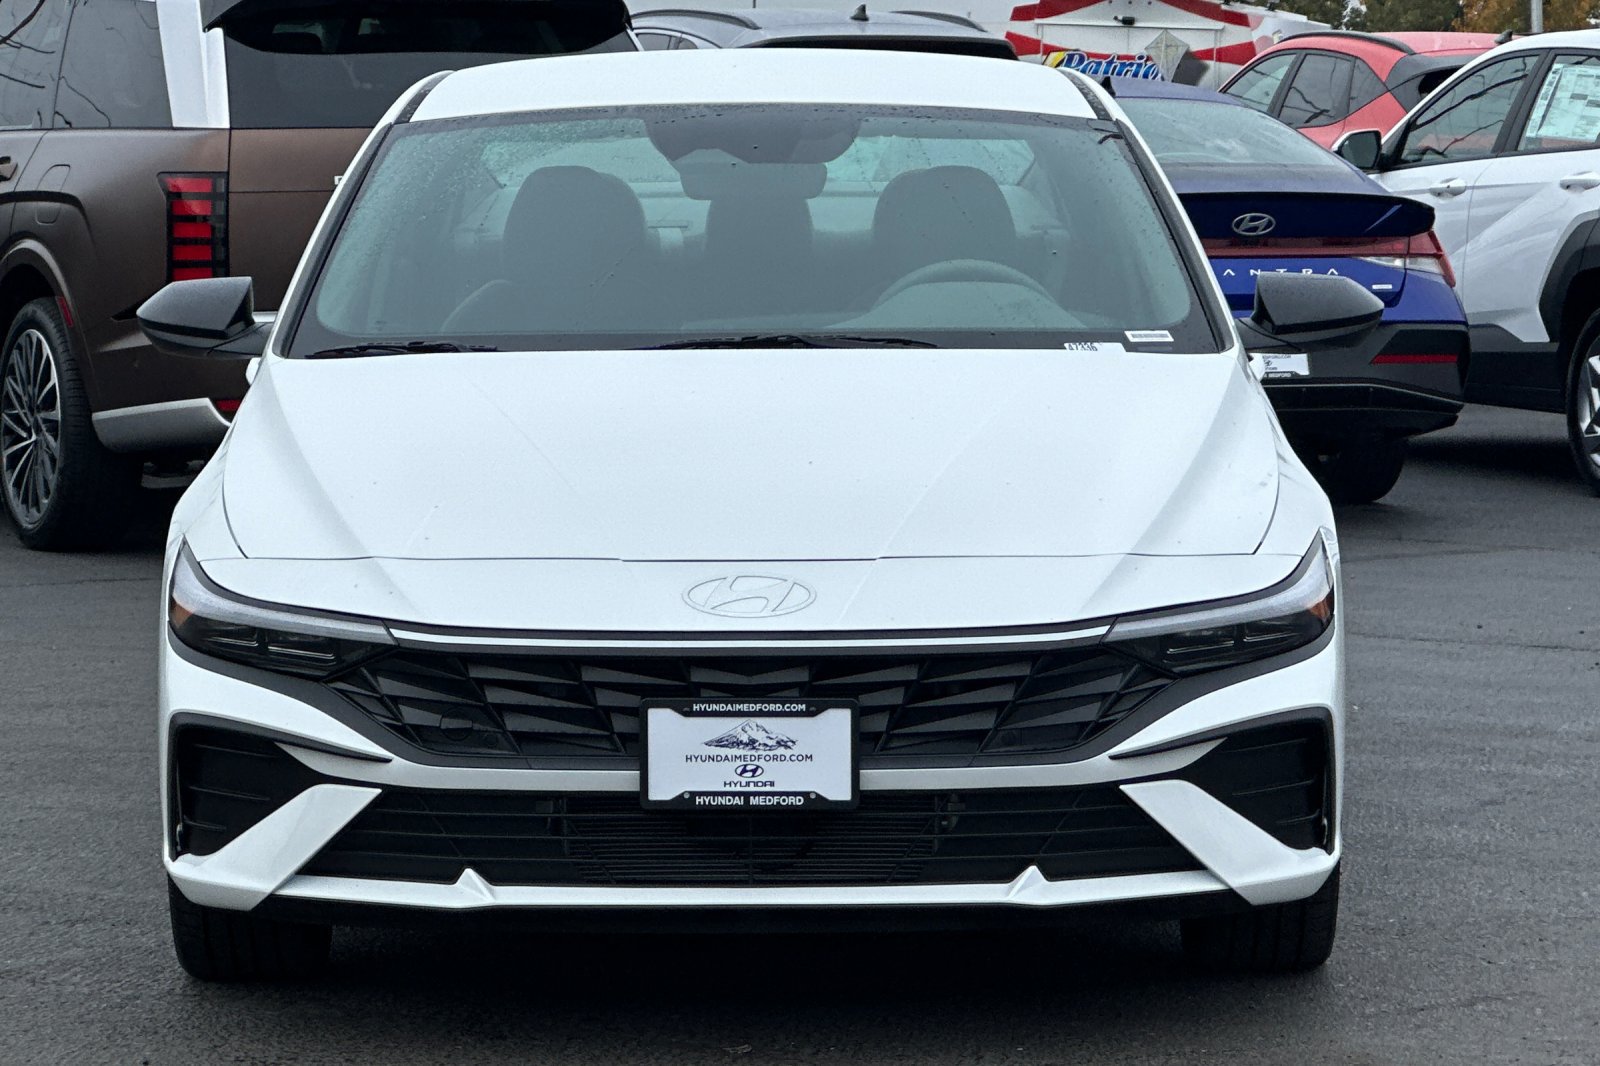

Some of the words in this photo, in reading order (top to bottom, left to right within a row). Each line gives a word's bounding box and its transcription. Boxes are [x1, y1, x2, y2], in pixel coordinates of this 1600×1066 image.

[692, 703, 806, 712] HYUNDAIMEDFORD.COM
[685, 754, 813, 763] HYUNDAIMEDFORD.COM
[723, 780, 775, 788] HYUNDAI
[695, 796, 744, 805] HYUNDAI
[749, 796, 804, 805] MEDFORD
